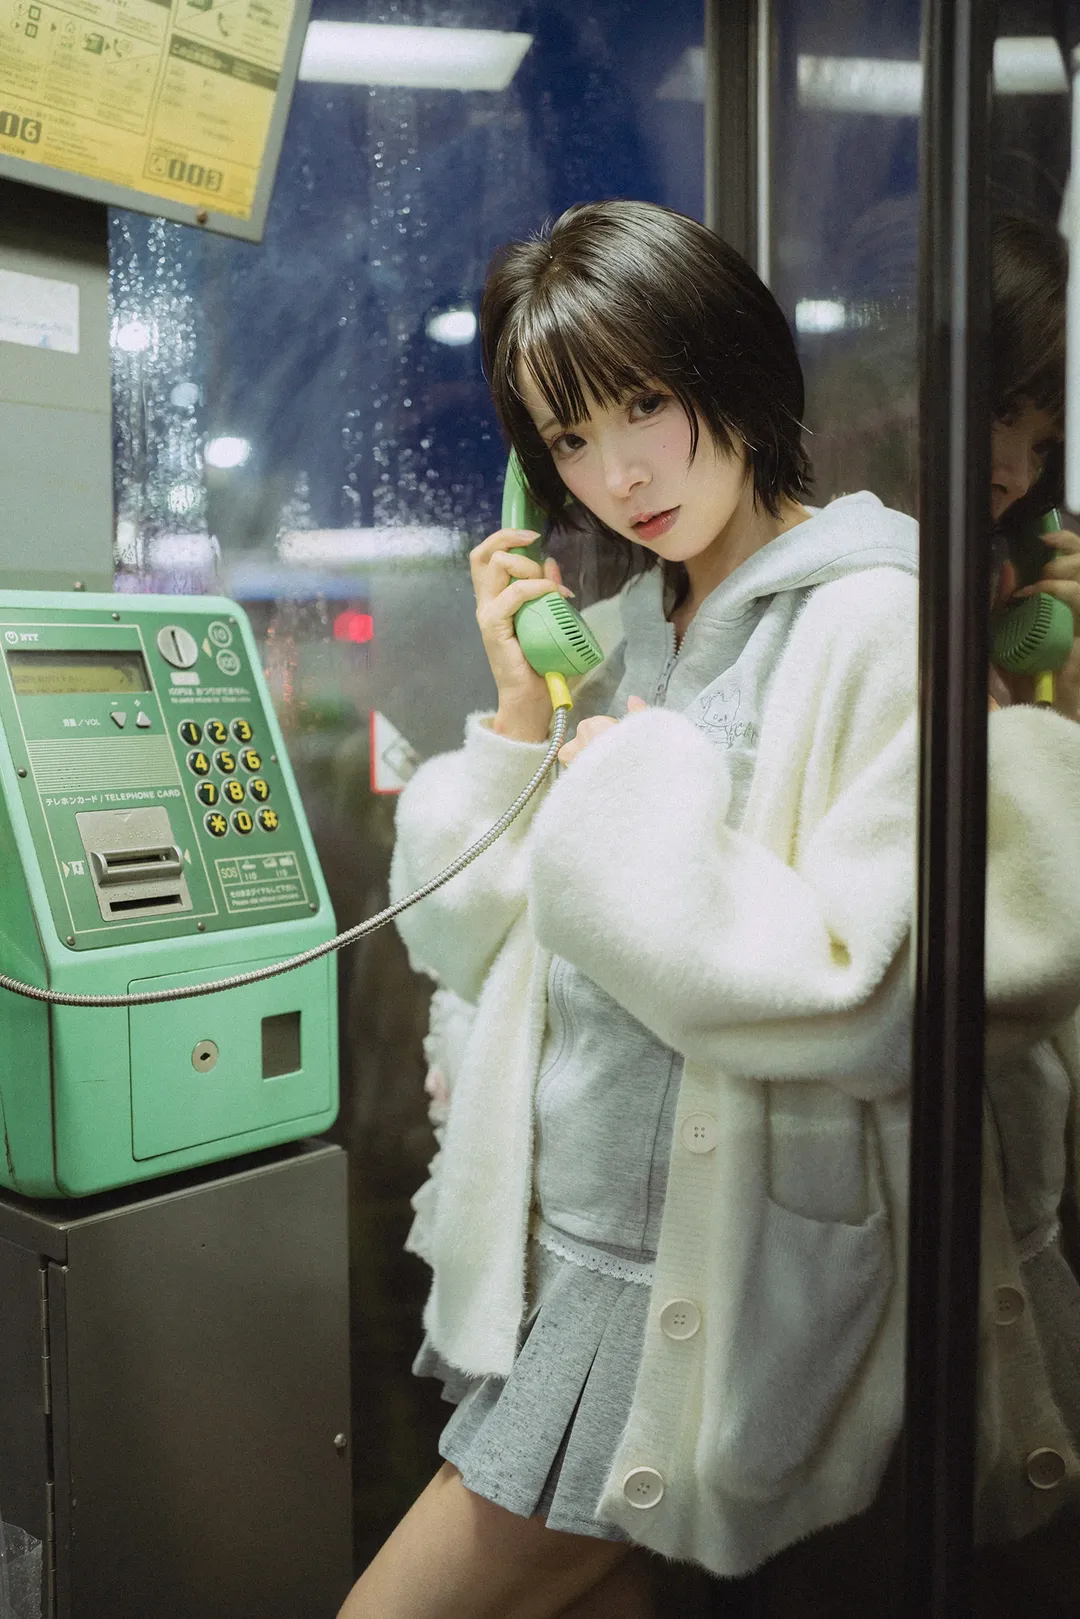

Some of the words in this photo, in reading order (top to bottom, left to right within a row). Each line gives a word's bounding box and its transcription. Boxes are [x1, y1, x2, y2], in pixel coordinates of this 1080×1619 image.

[190, 723, 198, 741] 1
[213, 721, 226, 740] 2
[238, 720, 251, 739] 3
[195, 752, 208, 771] 4
[221, 751, 234, 770] 5
[246, 750, 260, 769] 6
[45, 795, 98, 806] テレホンカード
[104, 790, 156, 802] TELEPHONE
[156, 788, 181, 799] CARD
[203, 783, 215, 802] 7
[229, 781, 244, 800] 8
[254, 779, 267, 799] 9
[237, 811, 252, 830] 0
[262, 809, 278, 828] #
[220, 867, 238, 879] SOS
